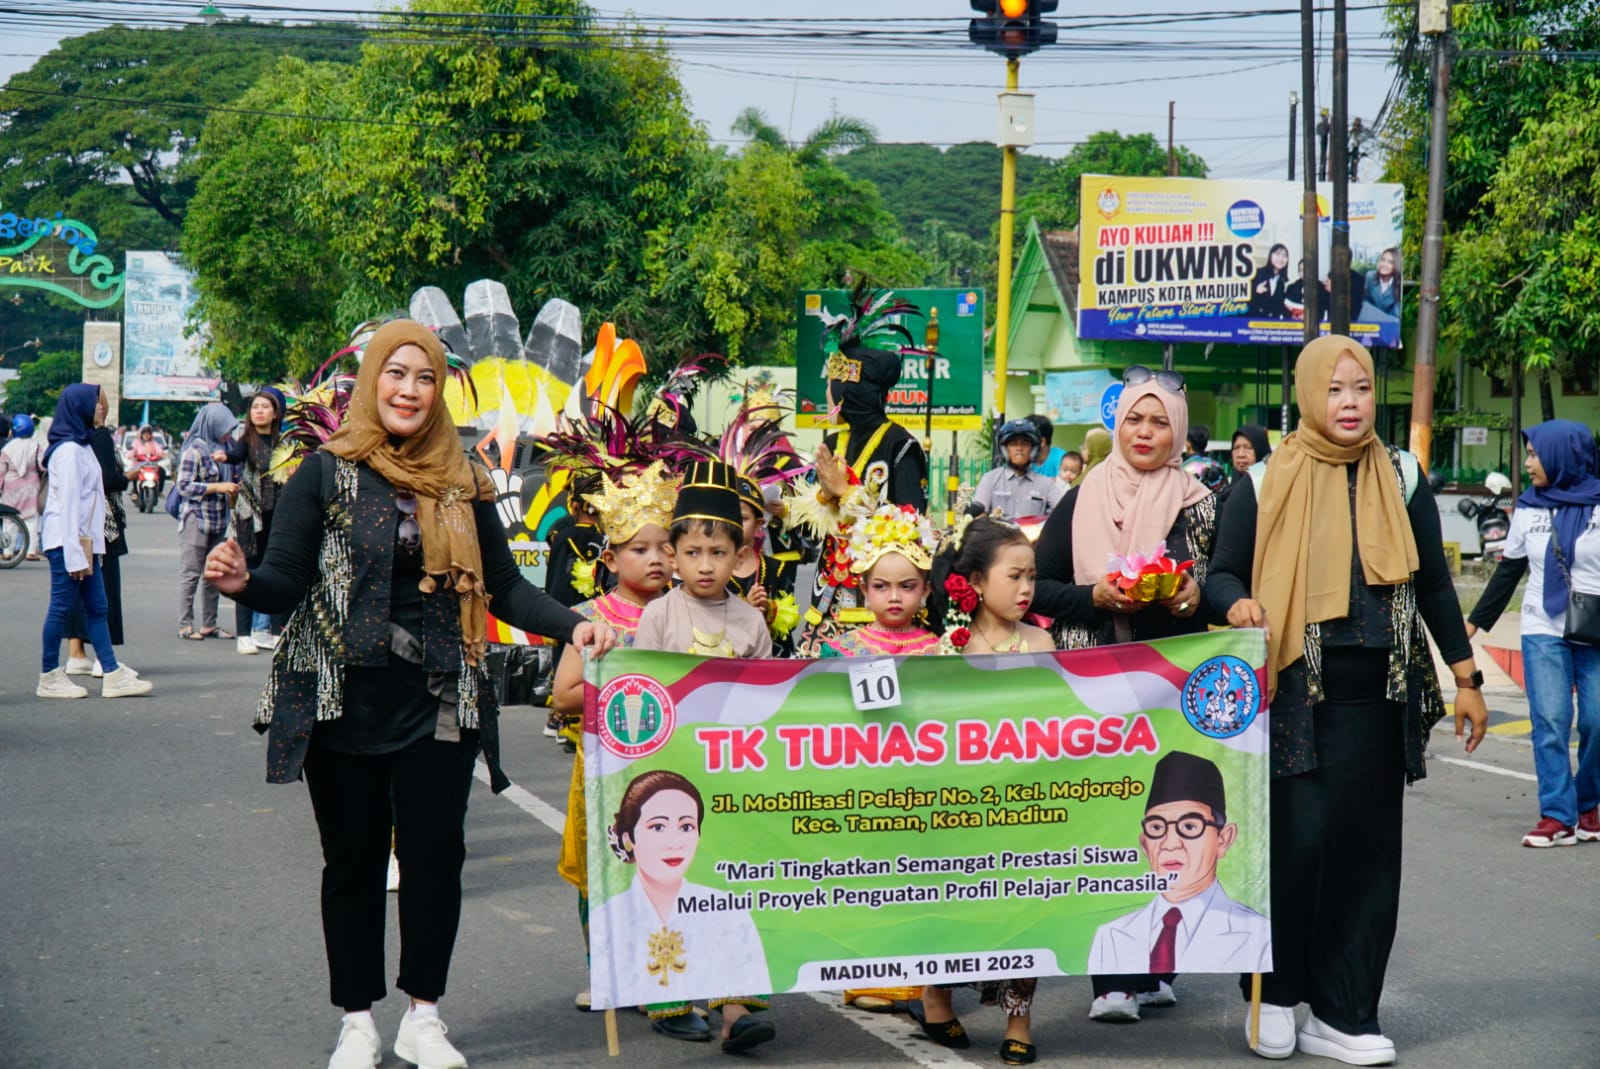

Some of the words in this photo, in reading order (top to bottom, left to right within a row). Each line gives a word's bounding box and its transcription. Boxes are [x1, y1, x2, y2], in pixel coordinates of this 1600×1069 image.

[1099, 227, 1130, 247] AYO
[1135, 223, 1193, 245] KULIAH
[1198, 223, 1214, 242] !!!
[1096, 250, 1125, 286] di
[1134, 243, 1254, 283] UKWMS
[1099, 287, 1155, 306] KAMPUS
[1159, 285, 1192, 303] KOTA
[1196, 282, 1249, 300] MADIUN
[1107, 305, 1133, 323] Your
[1137, 304, 1175, 320] Future
[1179, 301, 1215, 317] Starts
[1218, 298, 1248, 314] Here
[901, 358, 951, 379] RUR
[512, 549, 539, 567] TK
[856, 675, 895, 704] 10
[697, 727, 766, 771] TK
[778, 721, 946, 768] TUNAS
[958, 715, 1158, 762] BANGSA
[712, 795, 738, 812] Jl.
[743, 789, 853, 812] Mobilisasi
[859, 787, 936, 810] Pelajar
[941, 787, 976, 805] No.
[982, 786, 1001, 805] 2,
[1006, 783, 1045, 802] Kel.
[1050, 777, 1144, 802] Mojorejo
[793, 816, 841, 834] Kec.
[846, 815, 927, 833] Taman,
[931, 811, 982, 829] Kota
[987, 805, 1067, 826] Madiun
[780, 857, 890, 880] Tingkatkan
[896, 854, 996, 875] Semangat
[1001, 848, 1077, 868] Prestasi
[1083, 846, 1139, 864] Siswa
[677, 892, 752, 913] Melalui
[759, 888, 827, 911] Proyek
[833, 885, 939, 907] Penguatan
[945, 881, 997, 899] Profil
[1004, 878, 1072, 899] Pelajar
[820, 962, 908, 982] MADIUN,
[915, 960, 938, 976] 10
[945, 957, 980, 974] MEI
[987, 954, 1035, 971] 2023
